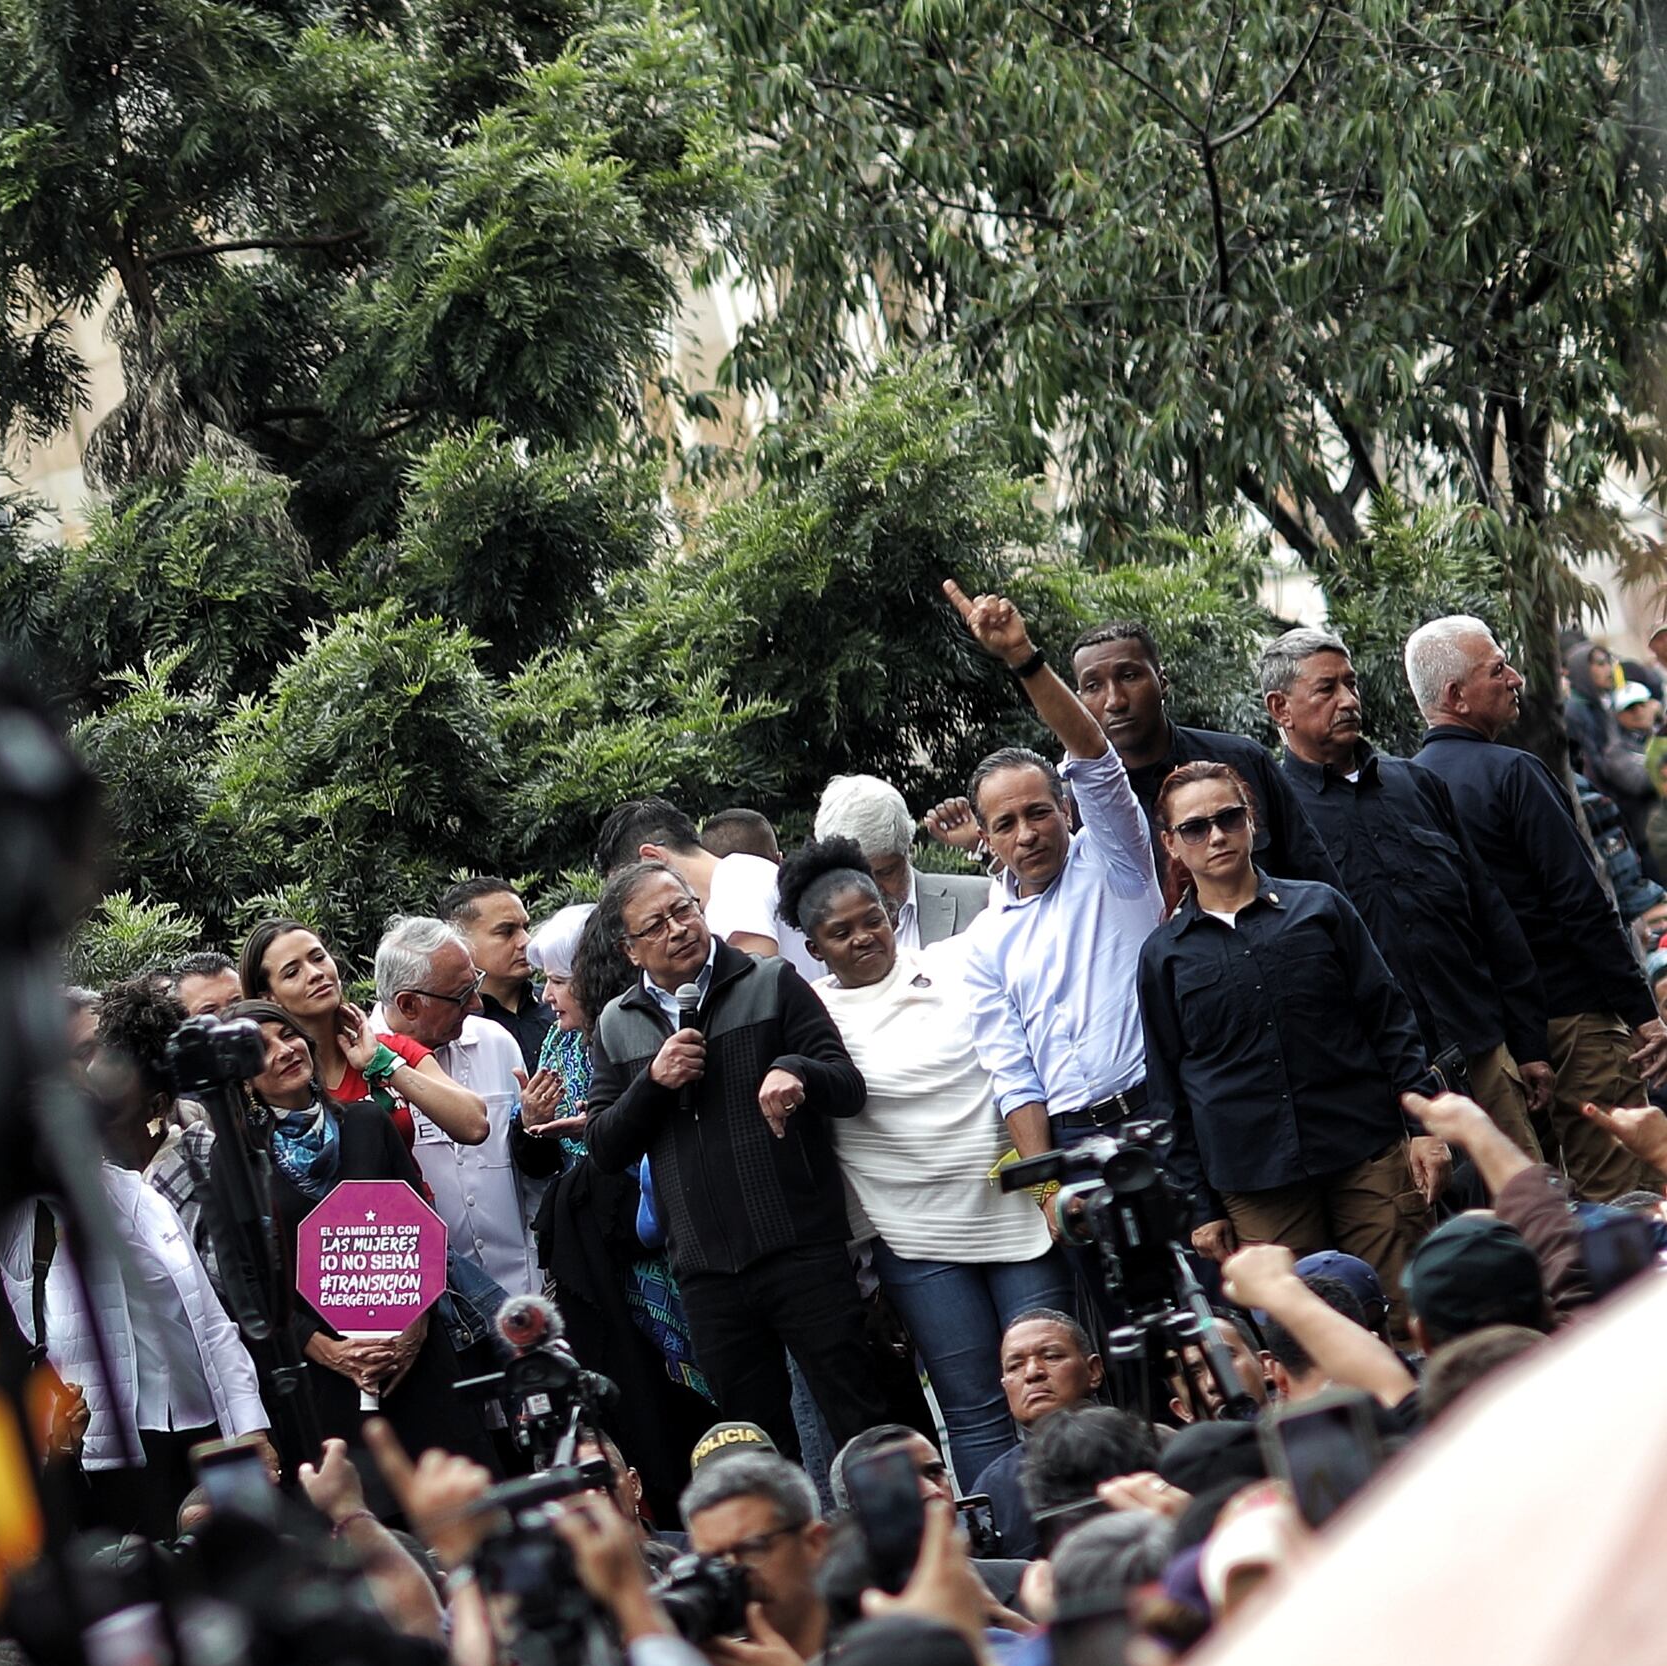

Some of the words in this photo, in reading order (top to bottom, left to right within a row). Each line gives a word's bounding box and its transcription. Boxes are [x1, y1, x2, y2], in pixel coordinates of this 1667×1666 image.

[320, 1227, 333, 1236] EL
[336, 1226, 377, 1236] CAMBIO
[380, 1226, 394, 1235] ES
[397, 1225, 420, 1235] CON
[322, 1237, 350, 1253] LAS
[353, 1236, 417, 1253] MUJERES
[342, 1254, 367, 1270] NO
[370, 1250, 420, 1270] SERÁ!
[320, 1271, 421, 1293] #TRANSICIÓN
[691, 1428, 763, 1468] POLICIA
